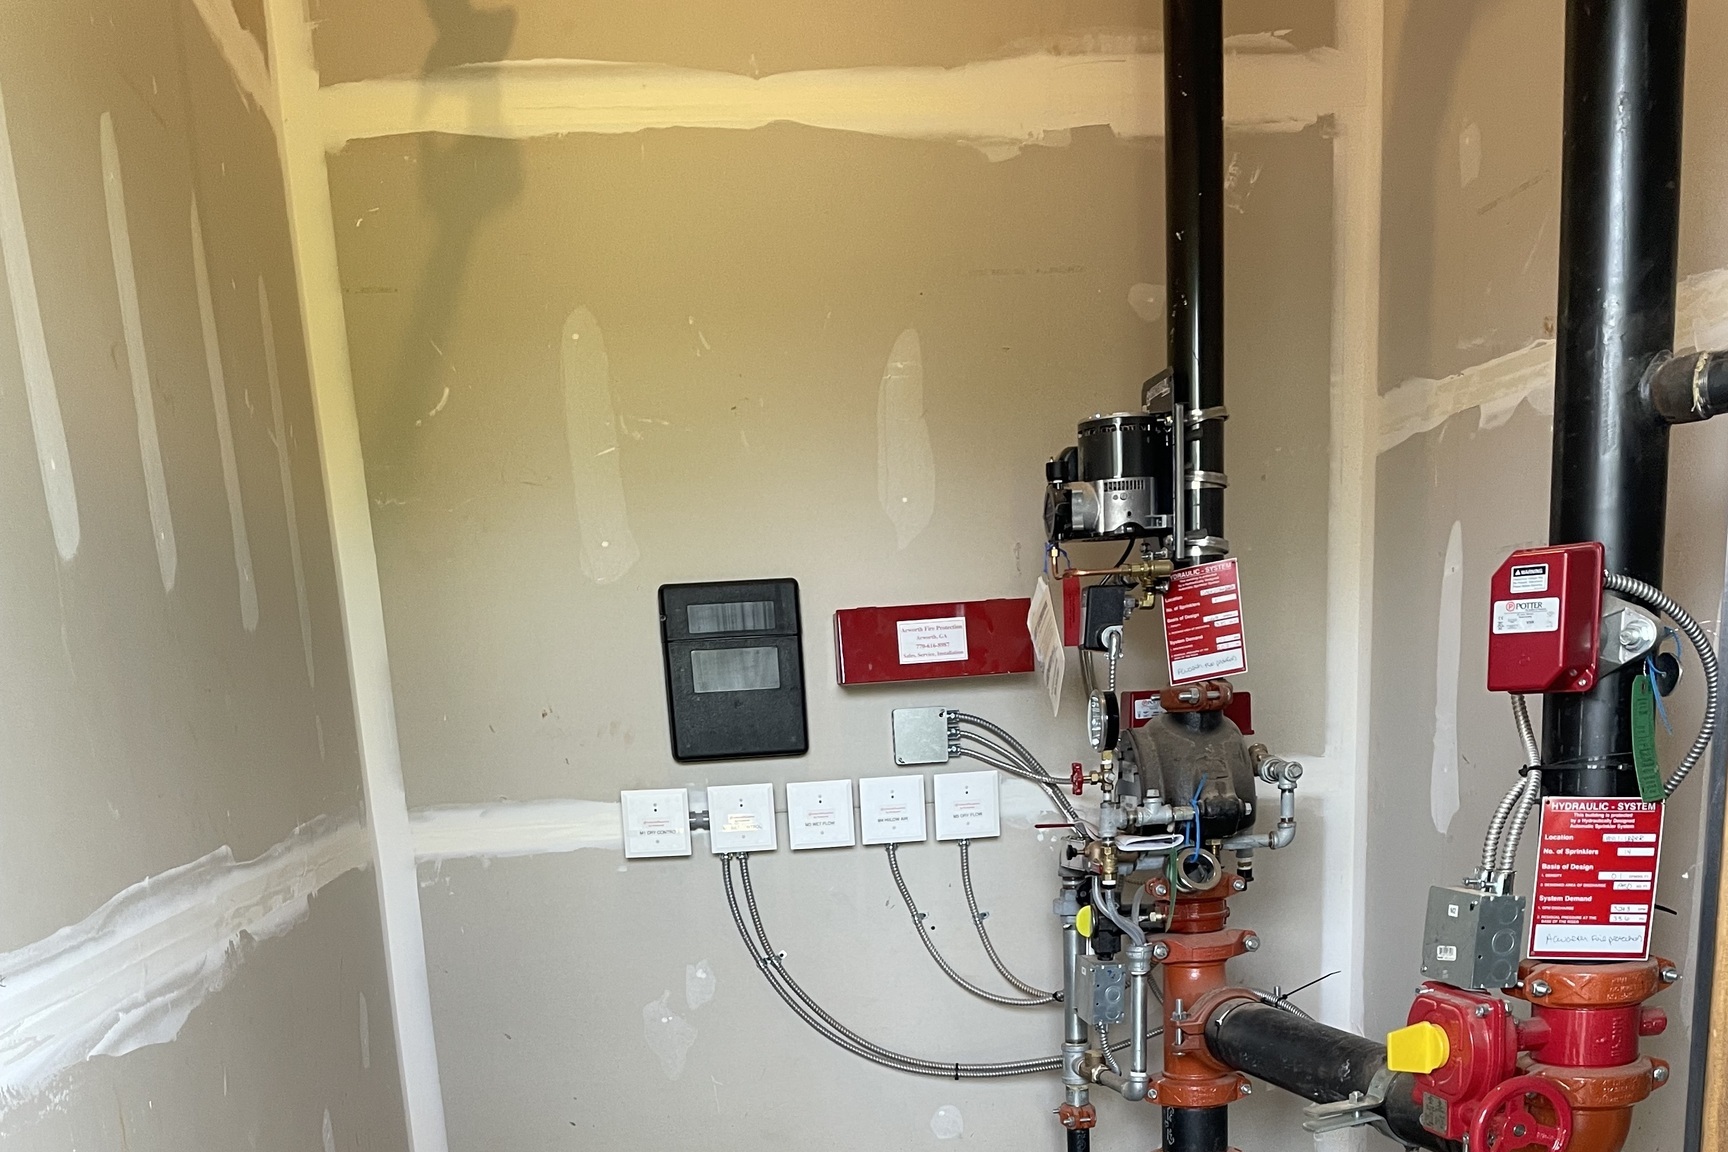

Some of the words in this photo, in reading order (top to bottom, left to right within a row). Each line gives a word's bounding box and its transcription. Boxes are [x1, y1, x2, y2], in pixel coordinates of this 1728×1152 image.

[1205, 562, 1232, 573] SYSTEM
[1516, 602, 1543, 610] POTTER
[1551, 802, 1609, 811] HYDRAULIC
[1618, 802, 1656, 811] SYSTEM
[1565, 848, 1599, 856] Sprinklers
[1570, 863, 1594, 871] Design
